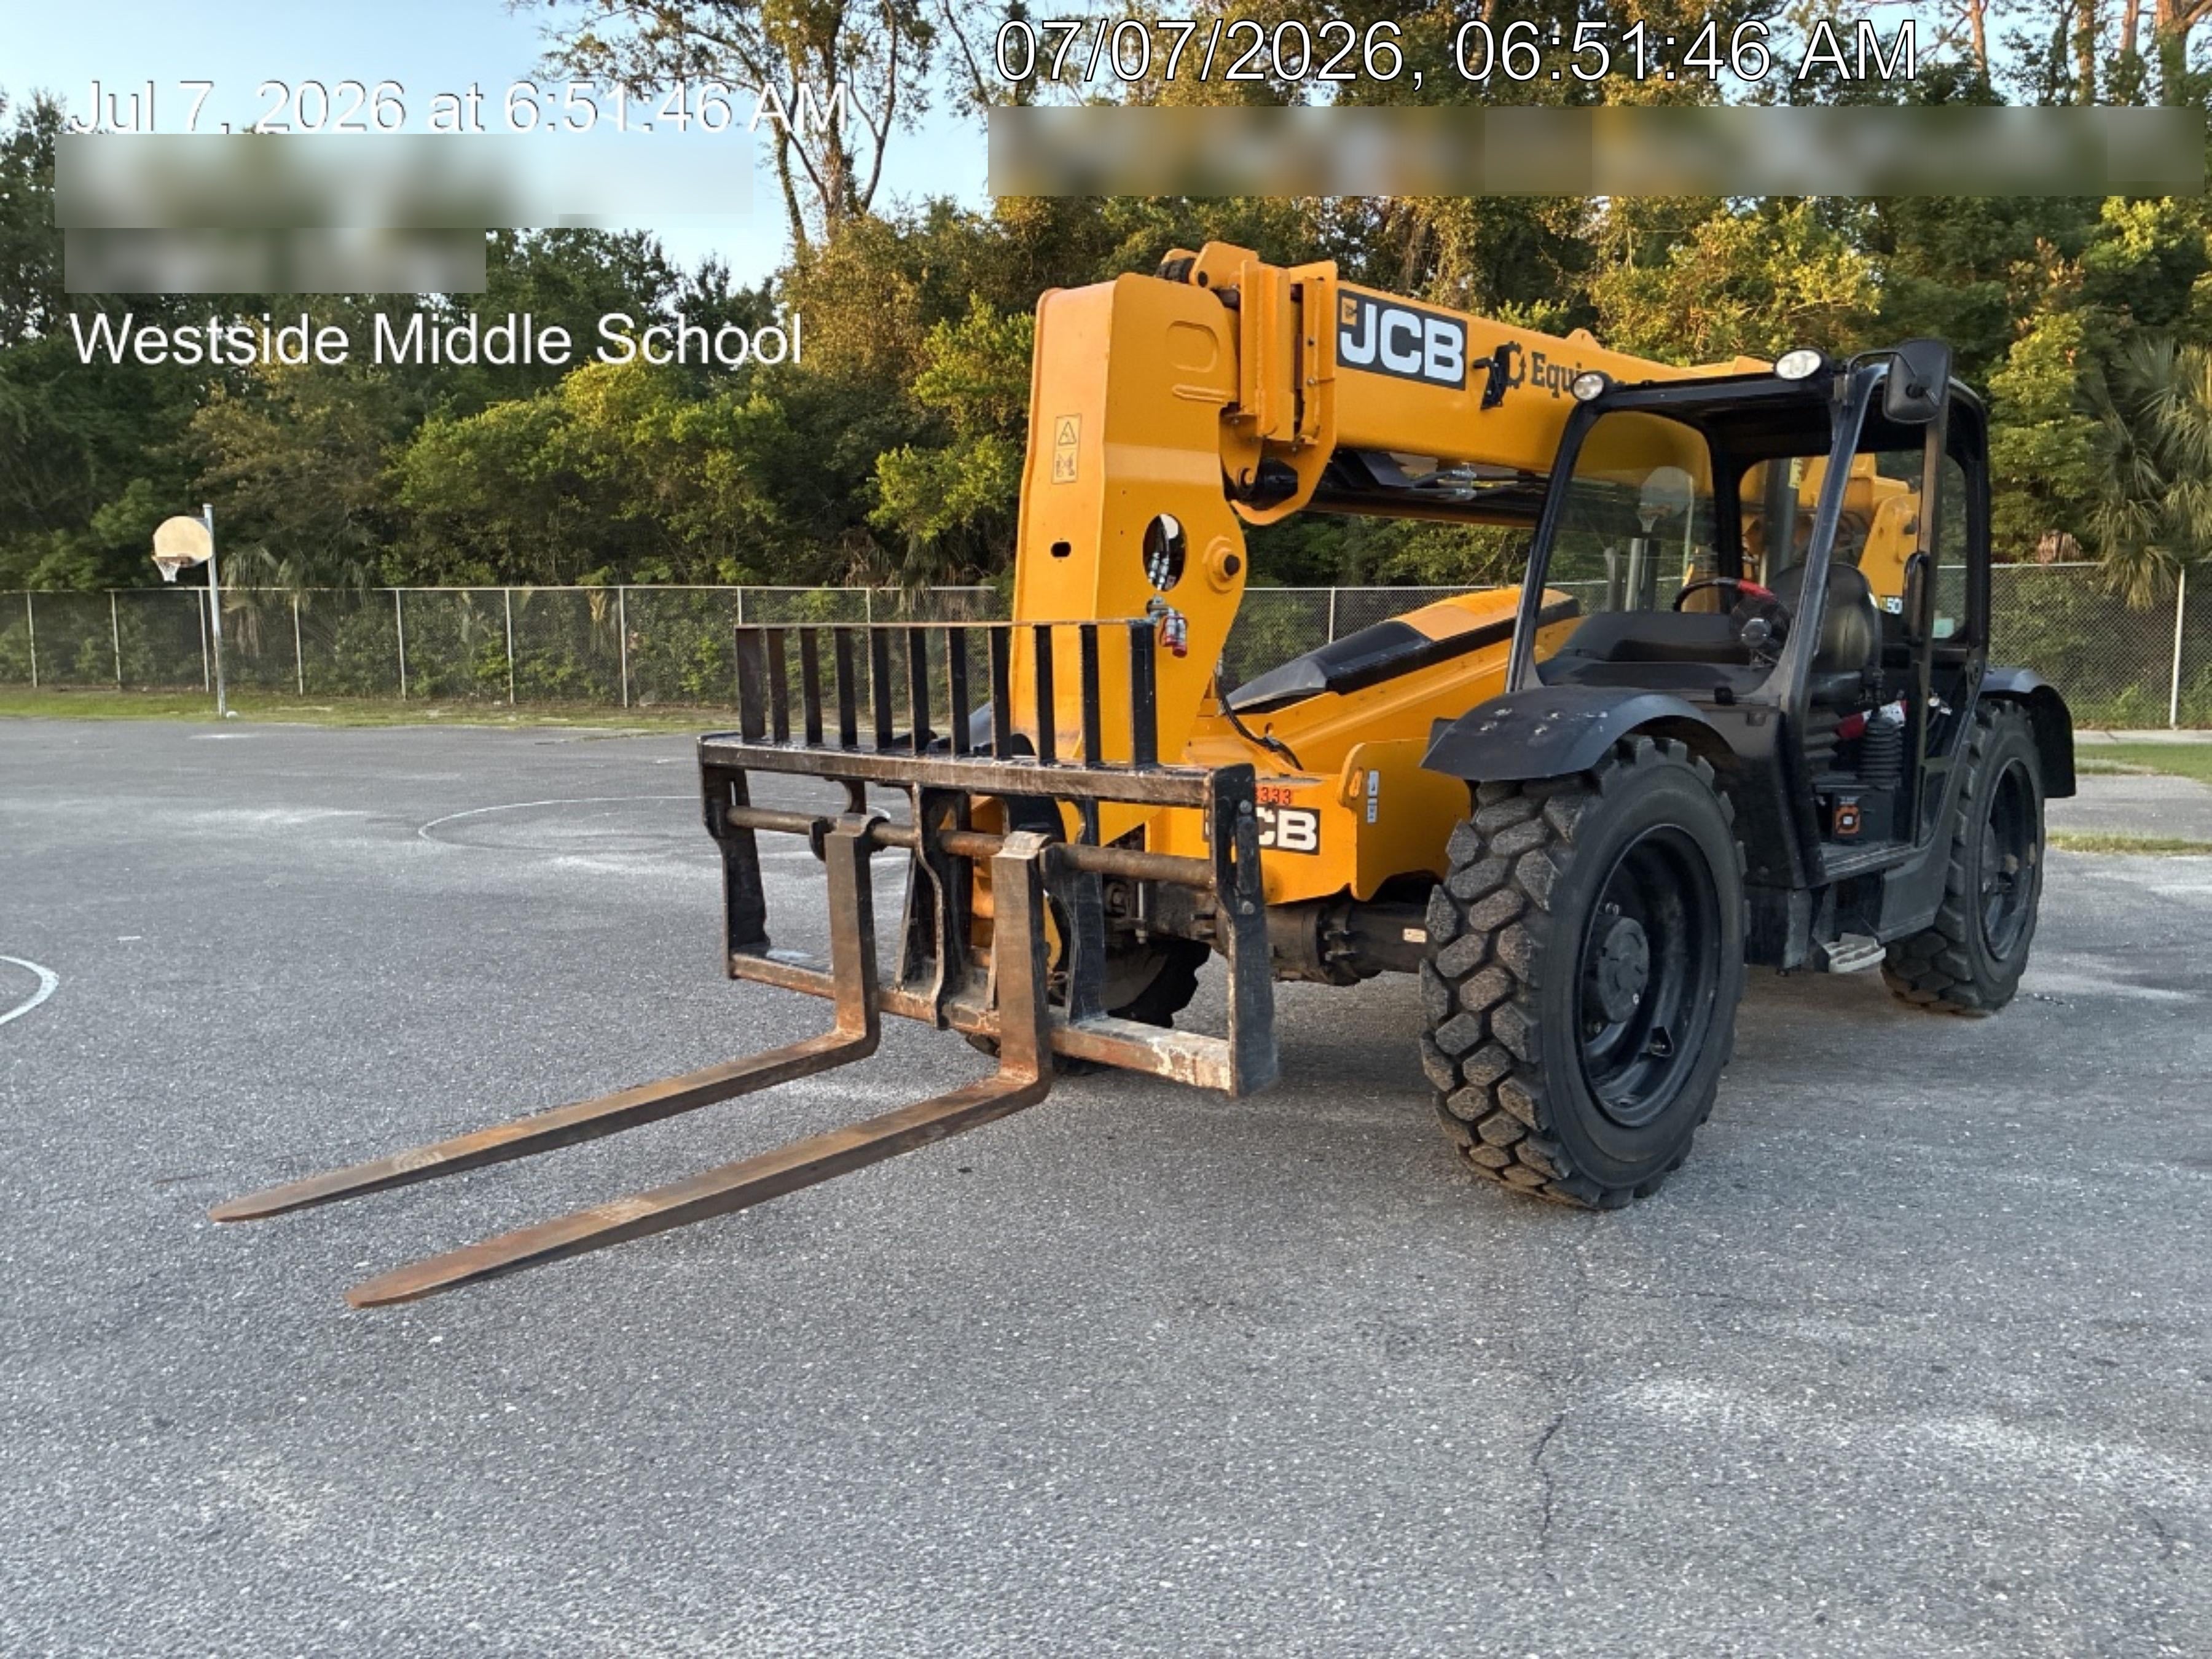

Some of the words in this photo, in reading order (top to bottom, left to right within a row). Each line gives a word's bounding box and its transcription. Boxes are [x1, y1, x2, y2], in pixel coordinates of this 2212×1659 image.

[1340, 303, 1464, 382] JCB
[1255, 786, 1292, 806] 333
[1255, 806, 1317, 851] CB
